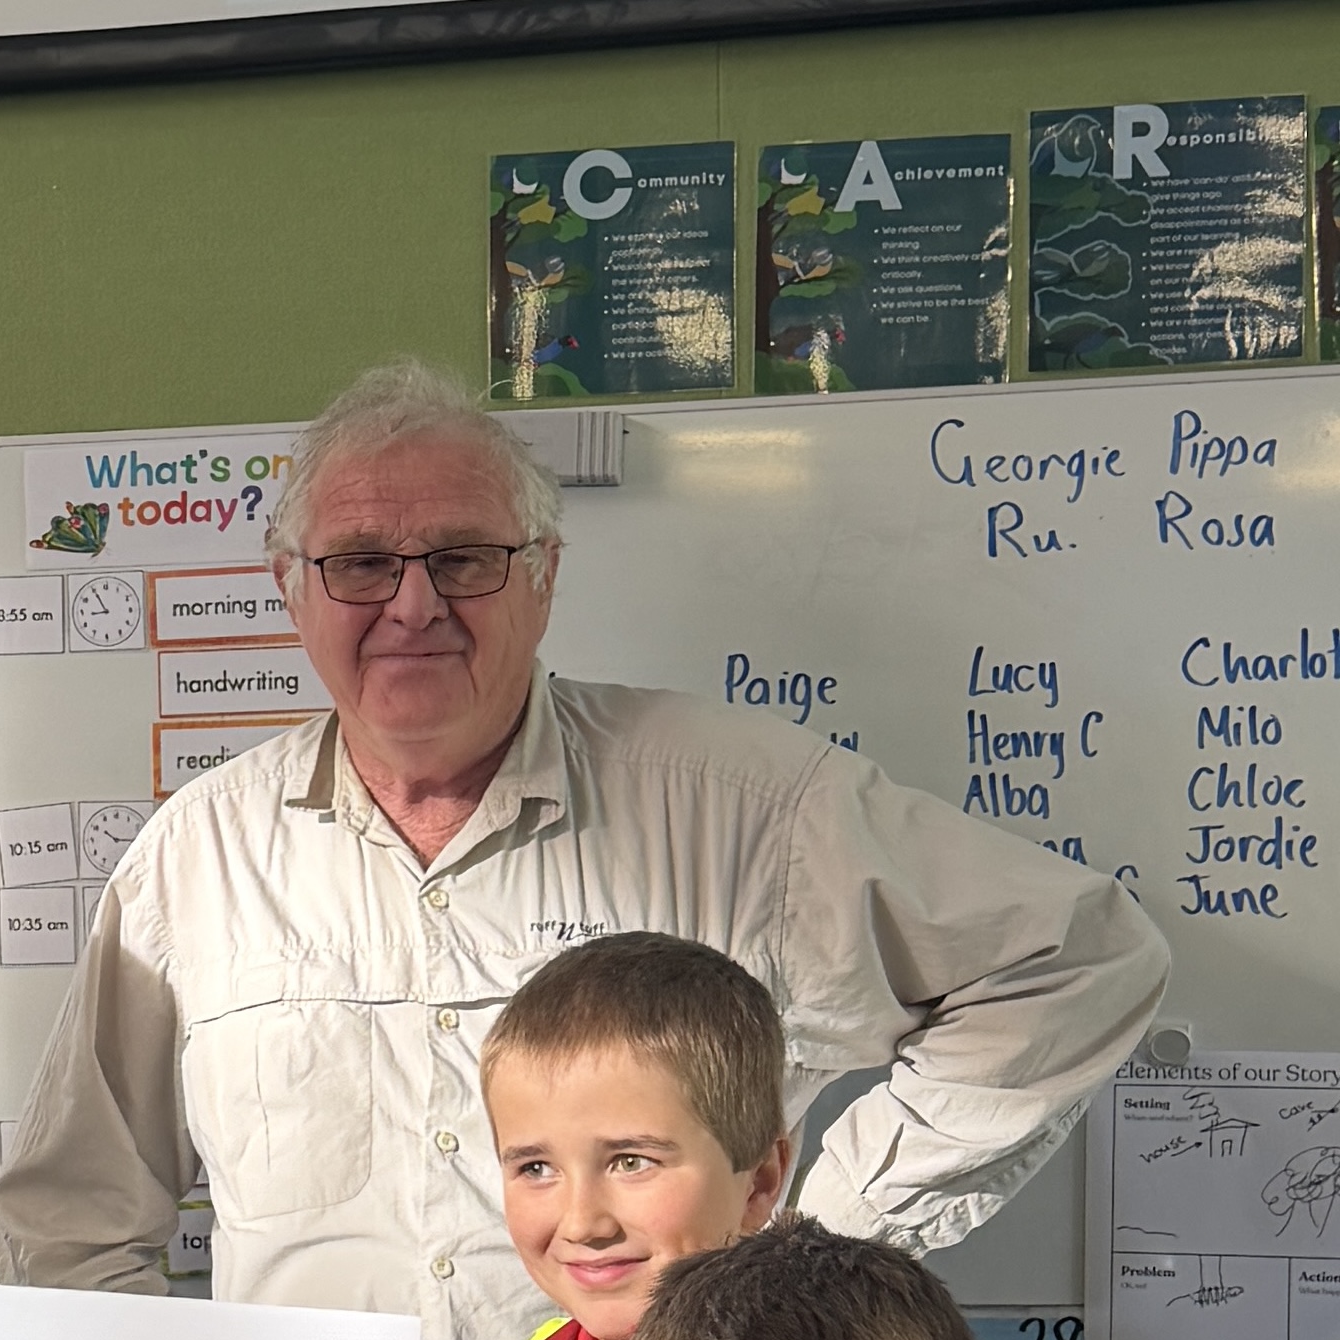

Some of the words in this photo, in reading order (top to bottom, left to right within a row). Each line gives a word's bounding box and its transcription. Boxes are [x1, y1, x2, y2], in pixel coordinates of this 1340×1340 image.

[1113, 104, 1294, 180] Responsibi
[563, 149, 726, 220] Community
[833, 140, 1004, 213] Achievement
[85, 450, 231, 489] What's
[931, 419, 1126, 503] Georgie
[1169, 410, 1278, 479] Pippa
[117, 485, 263, 532] today?
[1156, 491, 1275, 550] Rosa
[32, 610, 53, 622] am
[172, 594, 257, 619] morning
[176, 671, 300, 694] handwriting
[725, 653, 837, 725] Paige
[968, 646, 1059, 708] Lucy
[968, 710, 1065, 778] Henry
[1080, 710, 1103, 758] C
[1198, 706, 1282, 749] Milo
[963, 774, 1050, 818] Alba
[1188, 763, 1306, 811] Chloe
[9, 841, 41, 856] 10:15
[47, 842, 68, 852] am
[1186, 816, 1318, 869] Jordie
[1177, 875, 1288, 918] June
[8, 918, 42, 931] 10:35
[48, 921, 69, 931] am
[1115, 1060, 1213, 1080] Elements
[1218, 1061, 1240, 1080] of
[1246, 1067, 1281, 1082] our
[1286, 1064, 1340, 1087] Story
[1124, 1098, 1170, 1110] Setting
[1121, 1265, 1176, 1277] Problem
